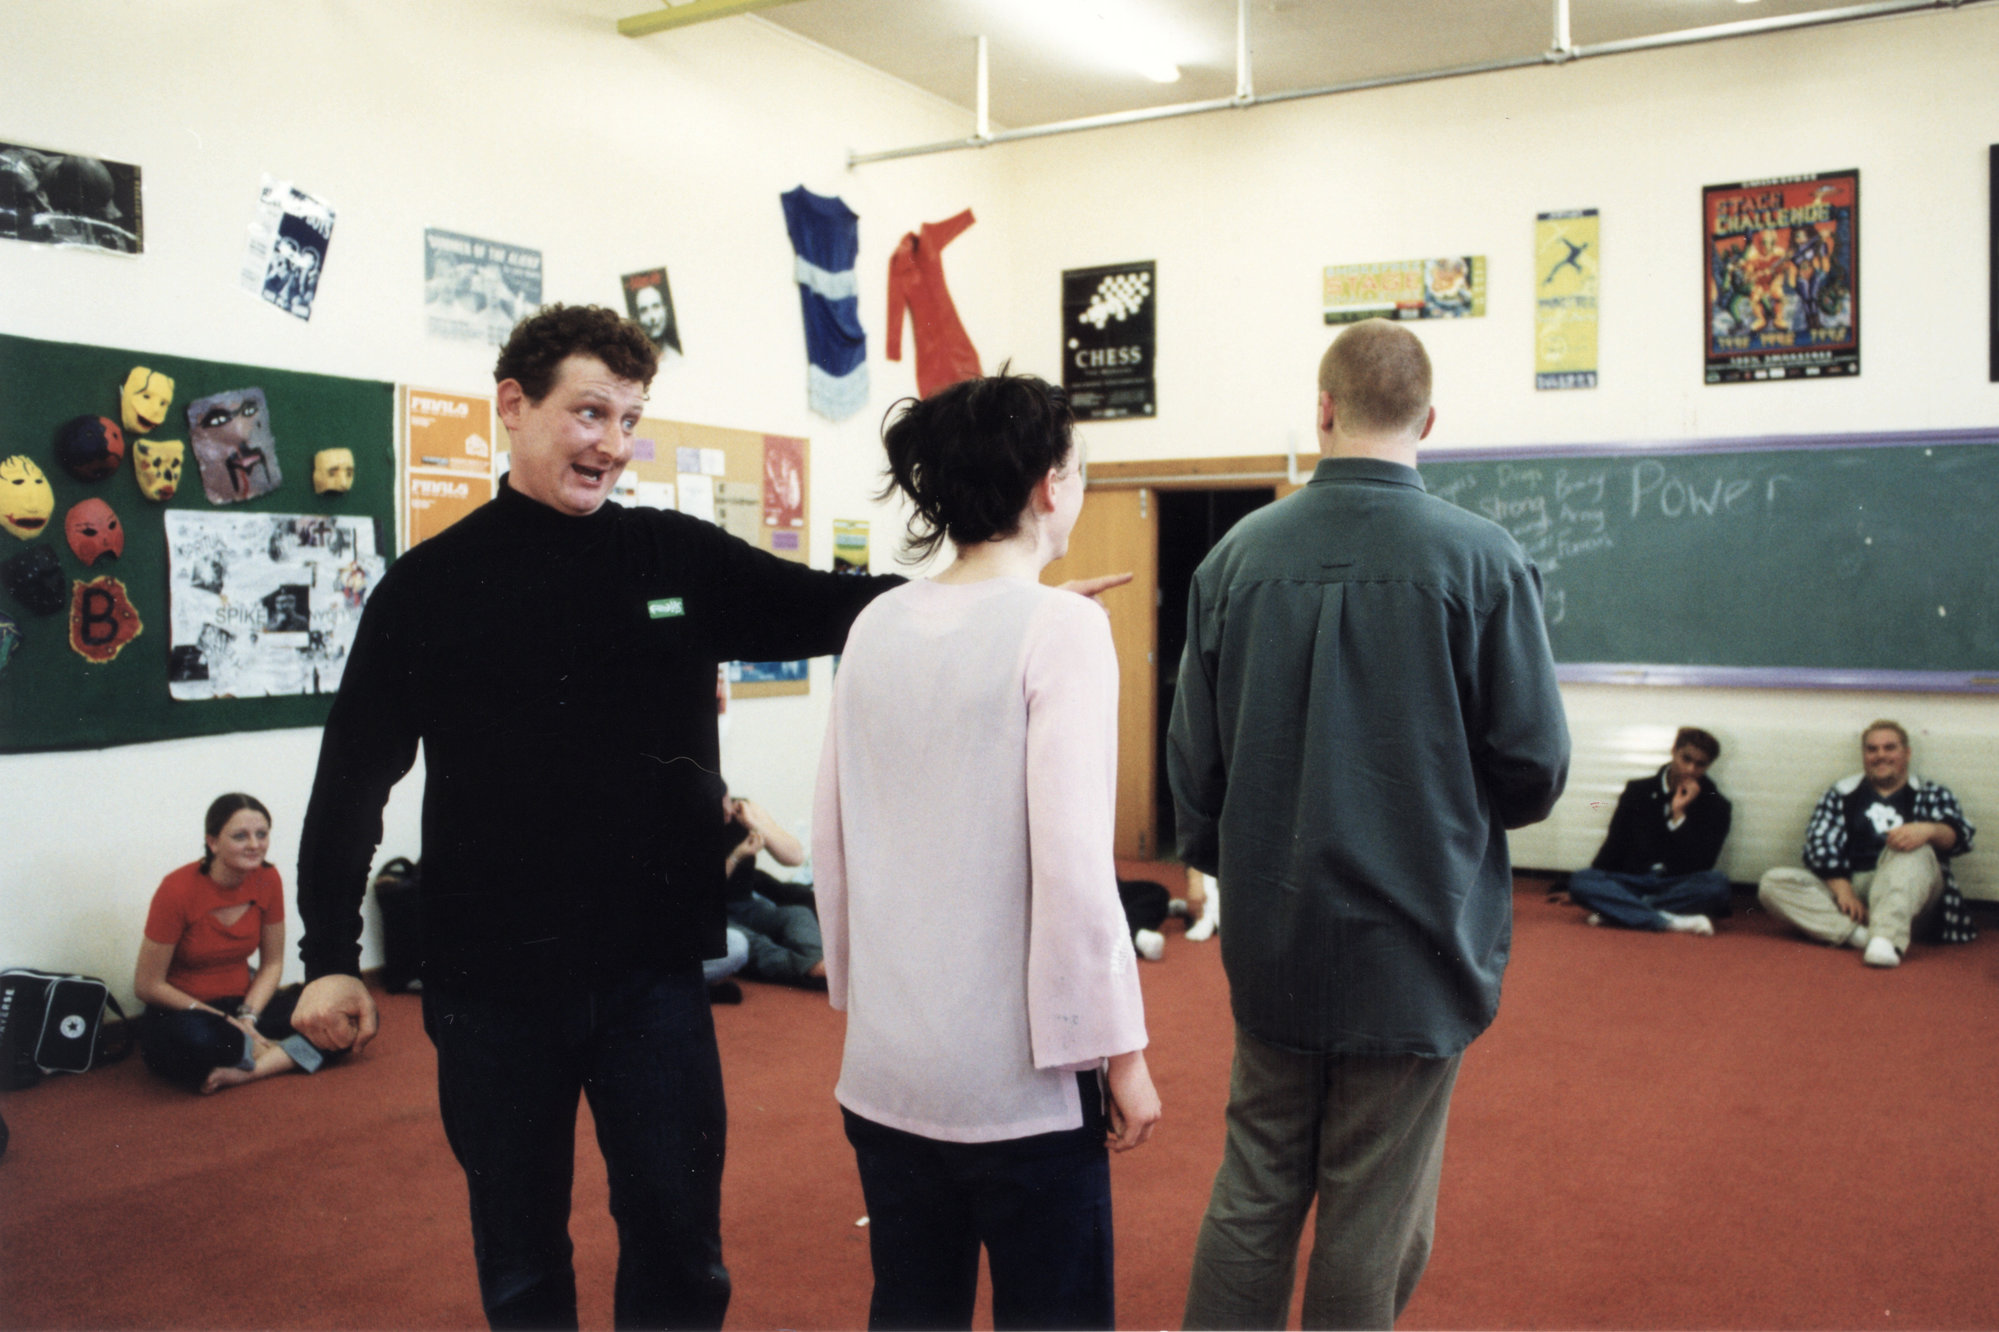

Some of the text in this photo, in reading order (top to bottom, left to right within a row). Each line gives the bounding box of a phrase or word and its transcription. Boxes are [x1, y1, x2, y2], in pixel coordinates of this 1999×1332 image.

[1715, 203, 1831, 235] CHALLENGE
[1325, 269, 1421, 295] STAGE
[1075, 347, 1142, 368] CHESS
[1631, 458, 1792, 518] Power
[81, 588, 118, 646] B
[215, 606, 268, 625] SPIKE
